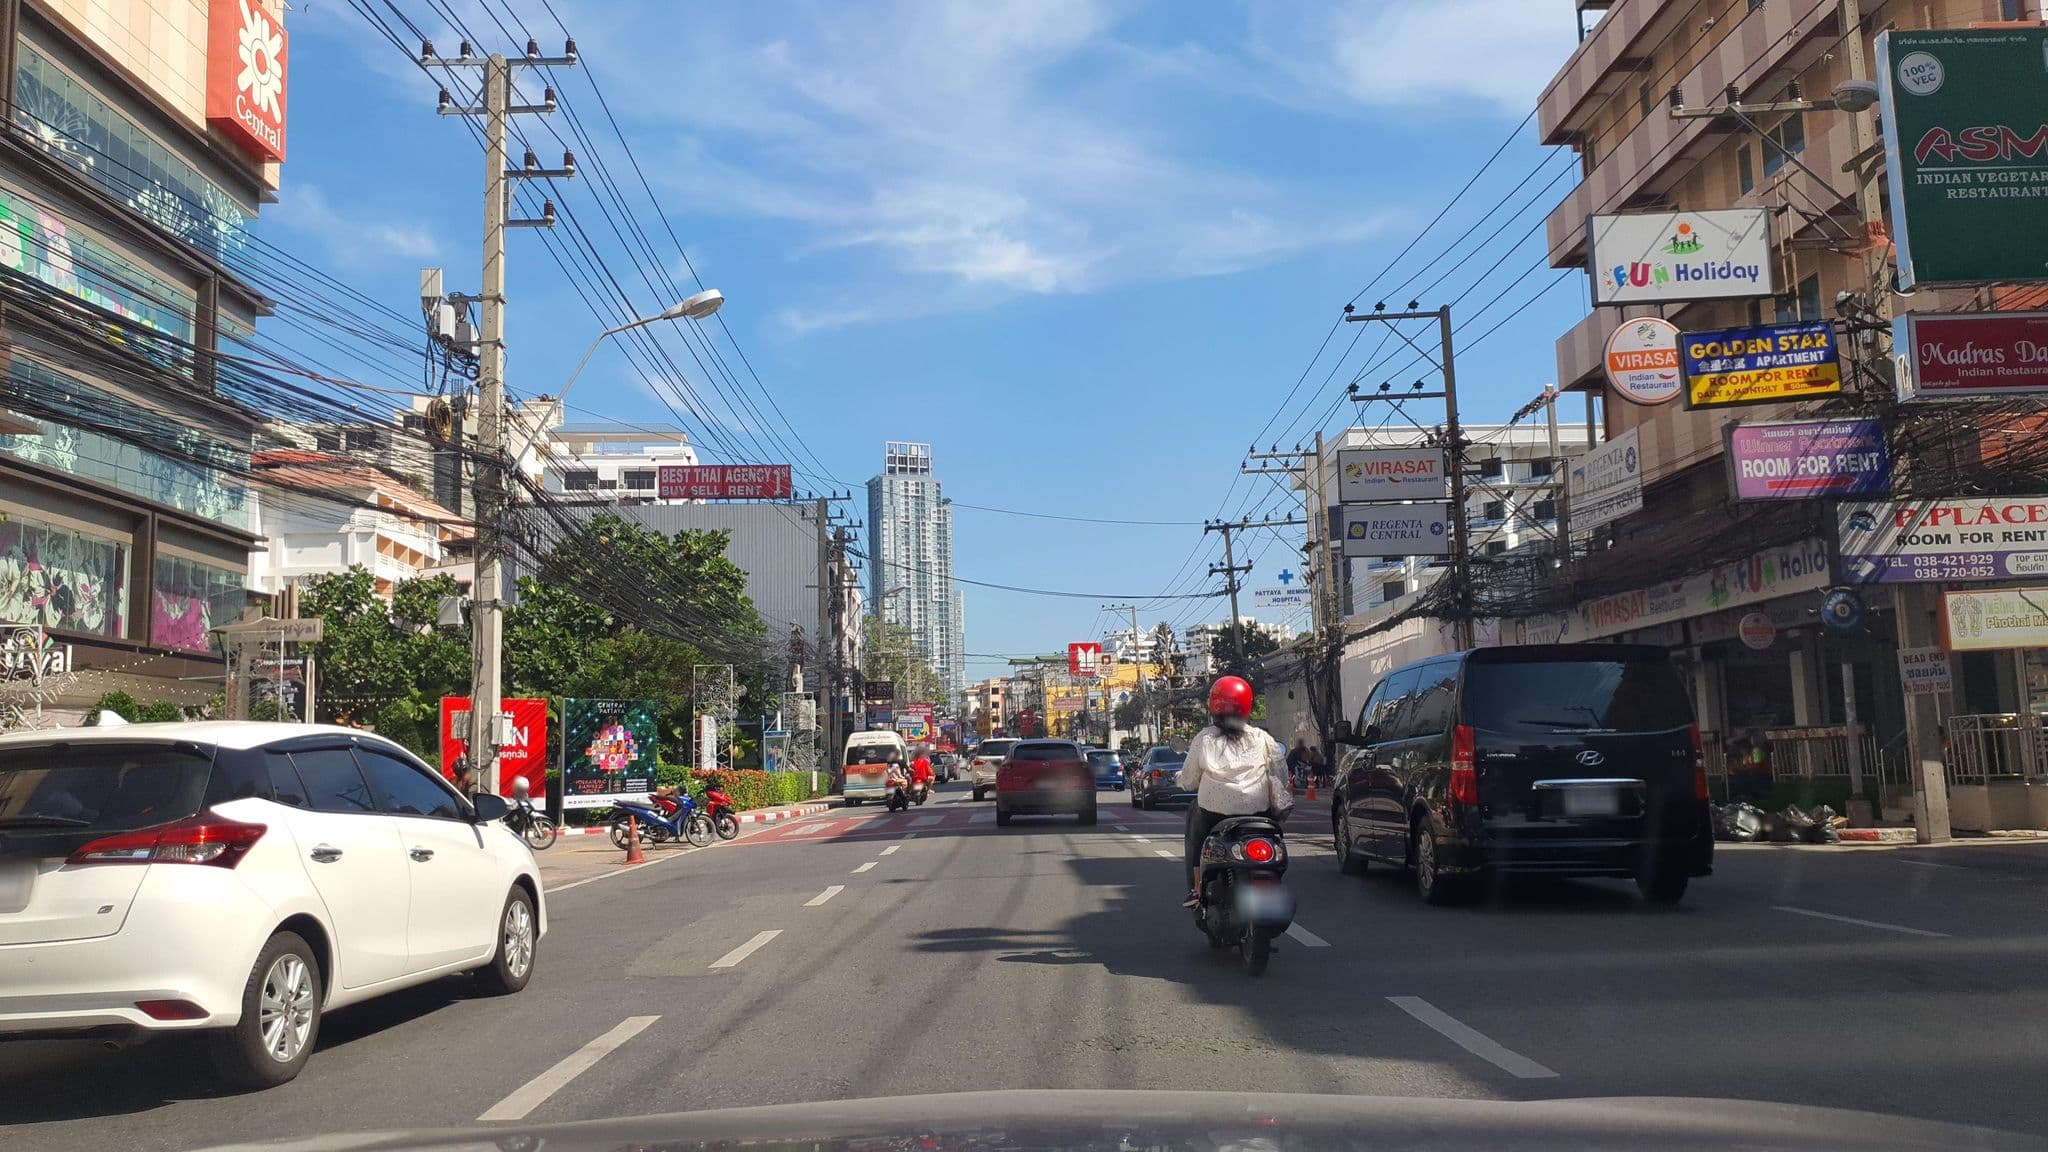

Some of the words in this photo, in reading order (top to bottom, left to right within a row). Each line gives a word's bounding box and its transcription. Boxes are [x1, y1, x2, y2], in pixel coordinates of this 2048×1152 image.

[236, 94, 281, 152] Central
[1916, 173, 1971, 185] INDIAN
[1946, 186, 2048, 199] RESTAURANT
[1675, 261, 1759, 283] Holiday
[1690, 337, 1773, 359] GOLDEN
[1778, 333, 1829, 352] STAR
[1921, 341, 2005, 366] Madras
[1615, 351, 1678, 368] VIRASA
[1756, 350, 1825, 367] APARTMENT
[1629, 373, 1655, 382] Indian
[1709, 373, 1752, 387] ROOM
[1755, 369, 1785, 383] FOR
[1787, 366, 1820, 380] RENT
[1958, 367, 1994, 377] Indian
[1630, 381, 1675, 390] Restaurant
[1697, 388, 1722, 400] DAILY
[1733, 385, 1778, 397] MONTHLY
[1364, 460, 1437, 475] VIRASAT
[1741, 458, 1791, 478] ROOM
[1797, 455, 1831, 475] FOR
[1836, 452, 1879, 473] RENT
[661, 468, 690, 483] BEST
[694, 467, 720, 483] THAI
[725, 467, 772, 483] AGENCY
[1402, 476, 1439, 484] Restaurant
[661, 485, 686, 496] BUY
[691, 485, 720, 496] SELL
[728, 485, 762, 496] RENT
[1895, 504, 2048, 528] P.PLACE
[1371, 519, 1423, 530] REGENTA
[1370, 530, 1422, 540] CENTRAL
[1896, 533, 1952, 547] ROOM
[1960, 531, 1994, 544] FOR
[2002, 530, 2047, 543] RENT
[1883, 556, 1908, 569] TEL.
[1914, 553, 1994, 568] 038-421-929
[2015, 553, 2030, 563] TOP
[1914, 566, 1995, 579] 038-720-052
[1255, 589, 1281, 597] PATTAYA
[1590, 590, 1647, 629] VIRASAT
[1987, 614, 2031, 629] Phothai
[1903, 654, 1926, 664] DEAD
[1928, 652, 1945, 662] END
